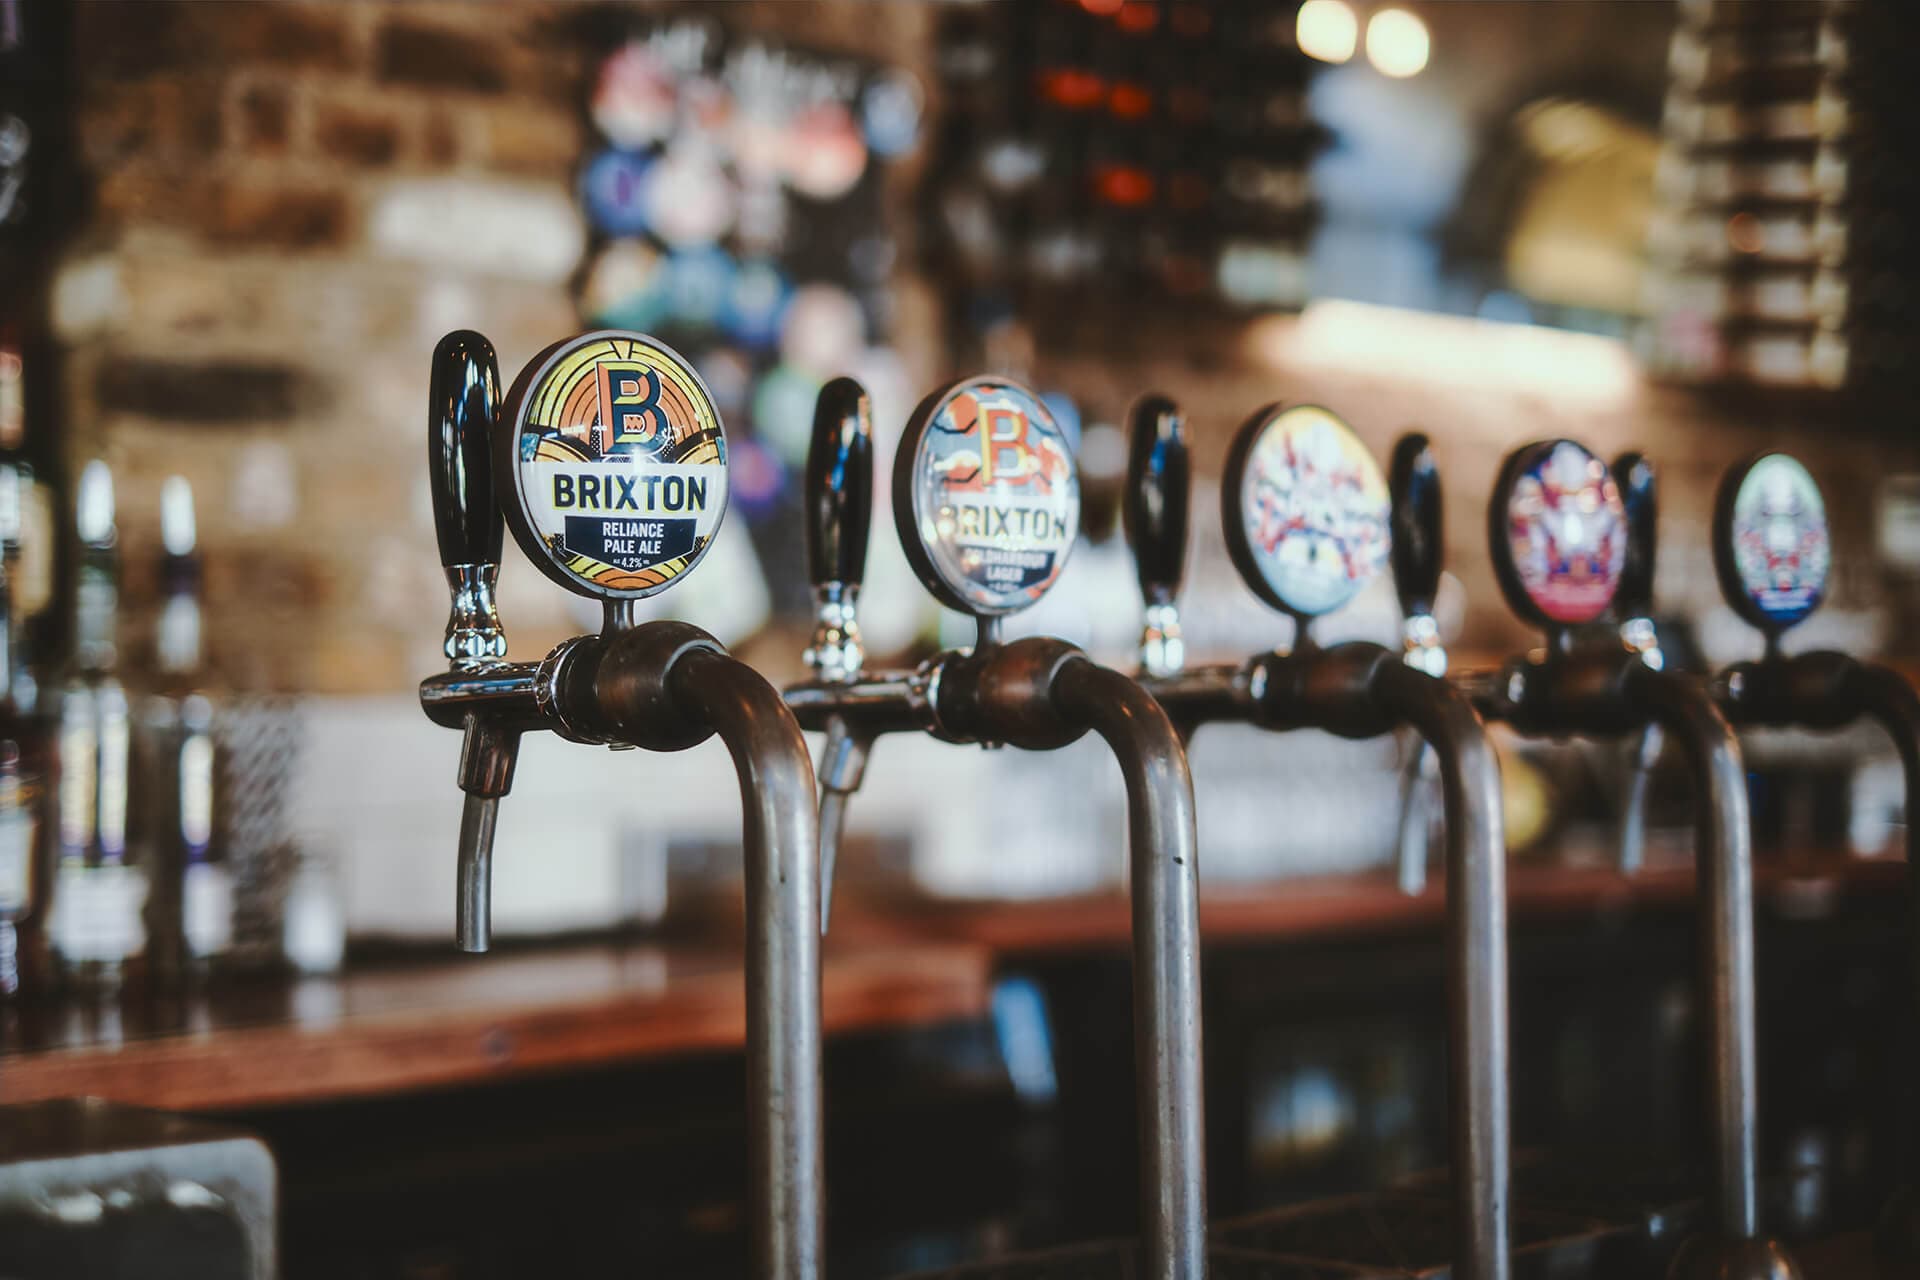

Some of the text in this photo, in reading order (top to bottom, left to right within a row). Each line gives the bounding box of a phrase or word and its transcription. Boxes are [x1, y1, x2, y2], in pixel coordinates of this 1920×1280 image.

[595, 360, 670, 457] B
[977, 401, 1034, 486] B
[553, 473, 707, 511] BRIXTON
[603, 522, 664, 538] RELIANCE
[604, 539, 662, 554] PALE ALE
[621, 557, 643, 568] 4.2%
